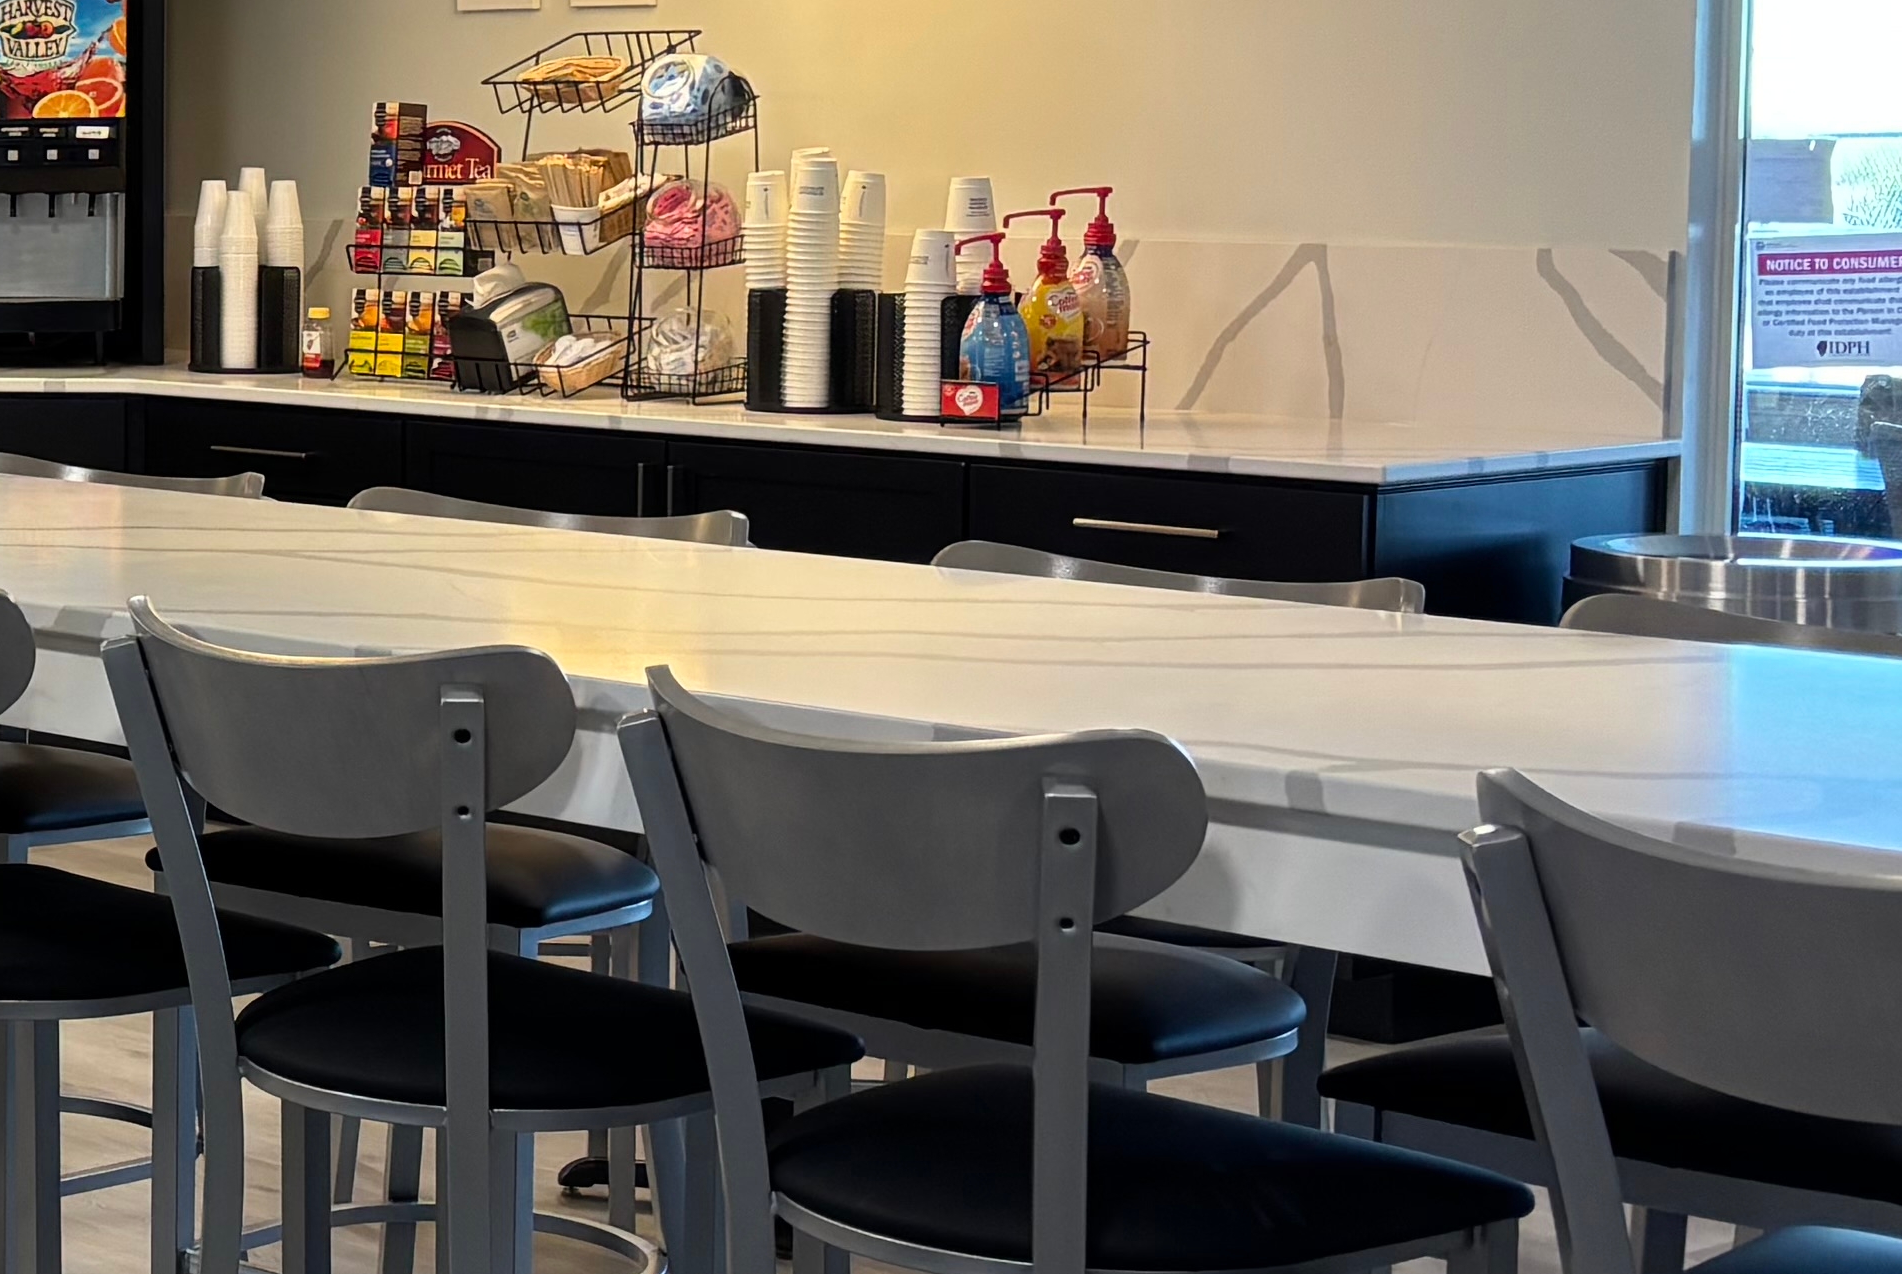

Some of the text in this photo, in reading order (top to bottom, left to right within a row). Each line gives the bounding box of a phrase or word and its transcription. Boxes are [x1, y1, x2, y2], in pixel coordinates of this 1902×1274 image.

[0, 0, 73, 23] HARVEST
[5, 37, 63, 59] VALLEY
[424, 158, 492, 179] rmet Tea
[1766, 258, 1812, 271] NOTICE
[1814, 257, 1829, 270] TO
[1829, 341, 1870, 354] IDPH
